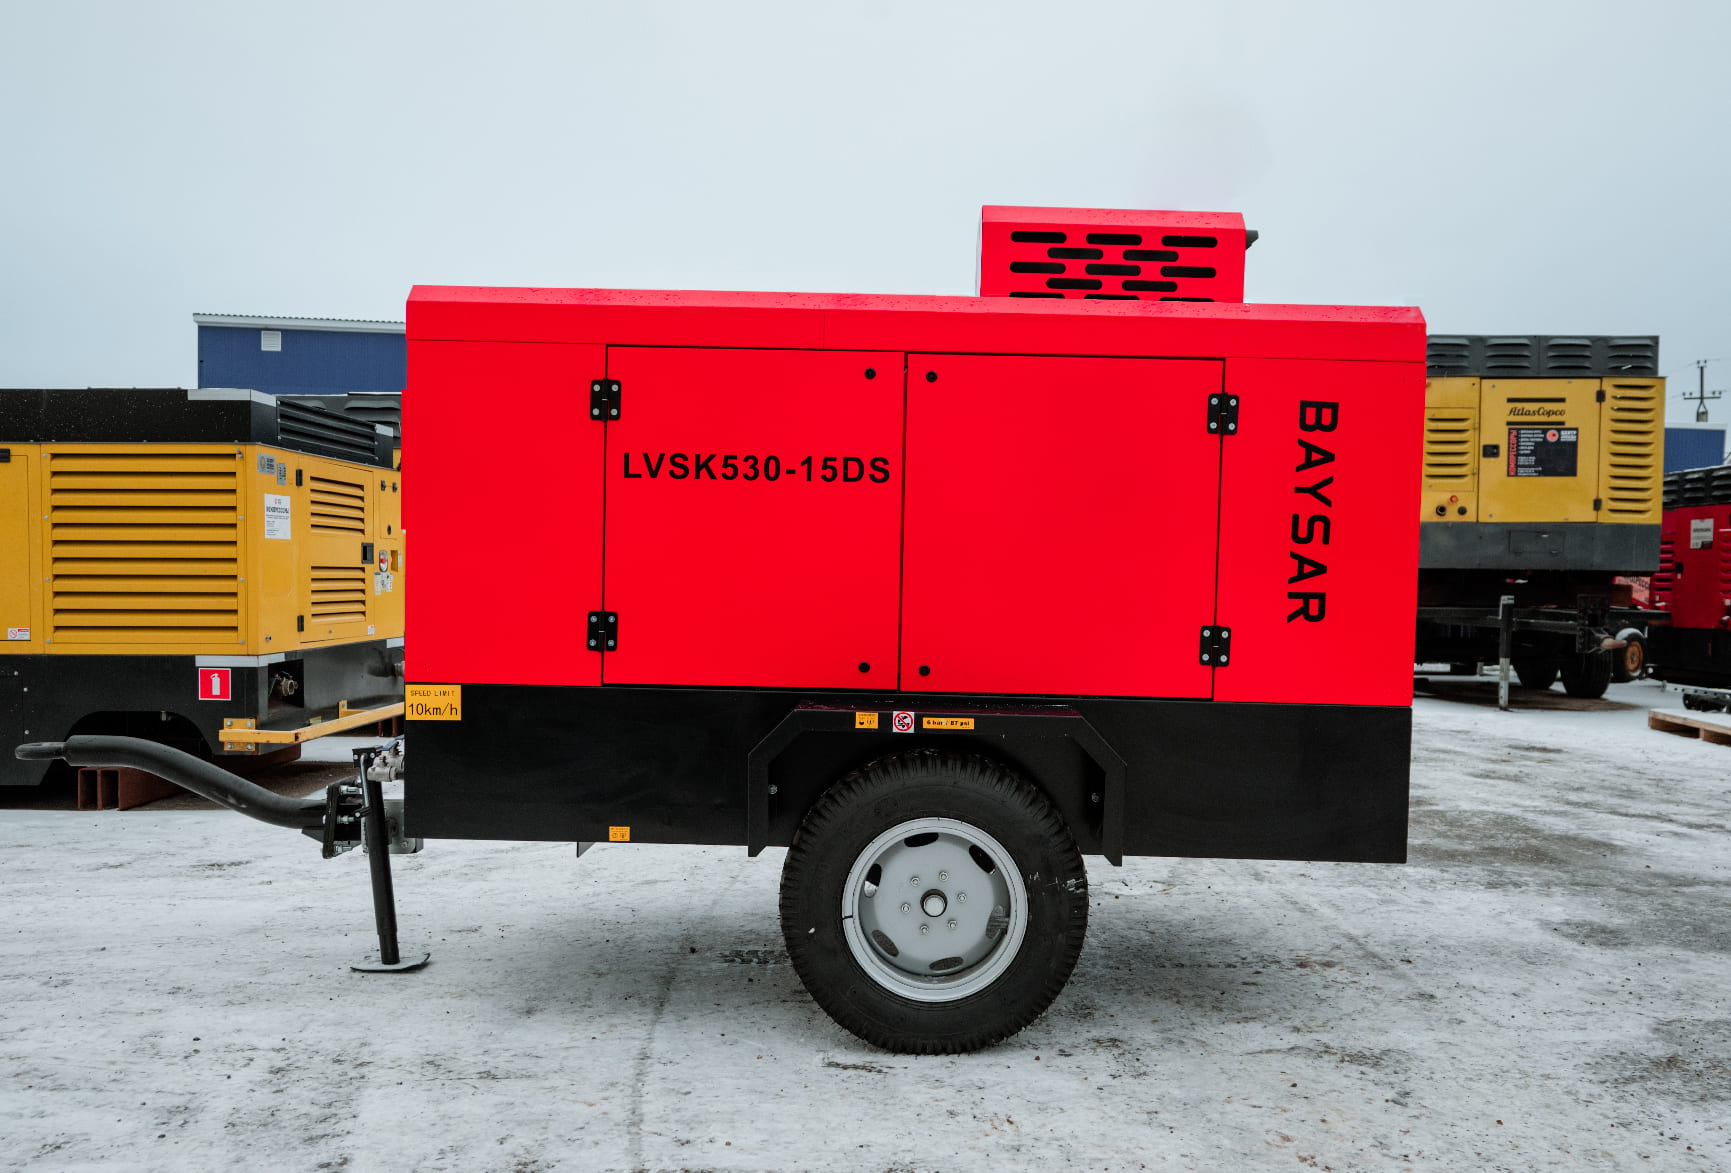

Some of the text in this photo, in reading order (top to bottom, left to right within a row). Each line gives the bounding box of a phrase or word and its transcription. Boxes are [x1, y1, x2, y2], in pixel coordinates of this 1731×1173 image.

[623, 452, 890, 484] LVSK530-15DS
[1287, 400, 1339, 624] BAYSAR
[409, 702, 458, 716] 10km/h
